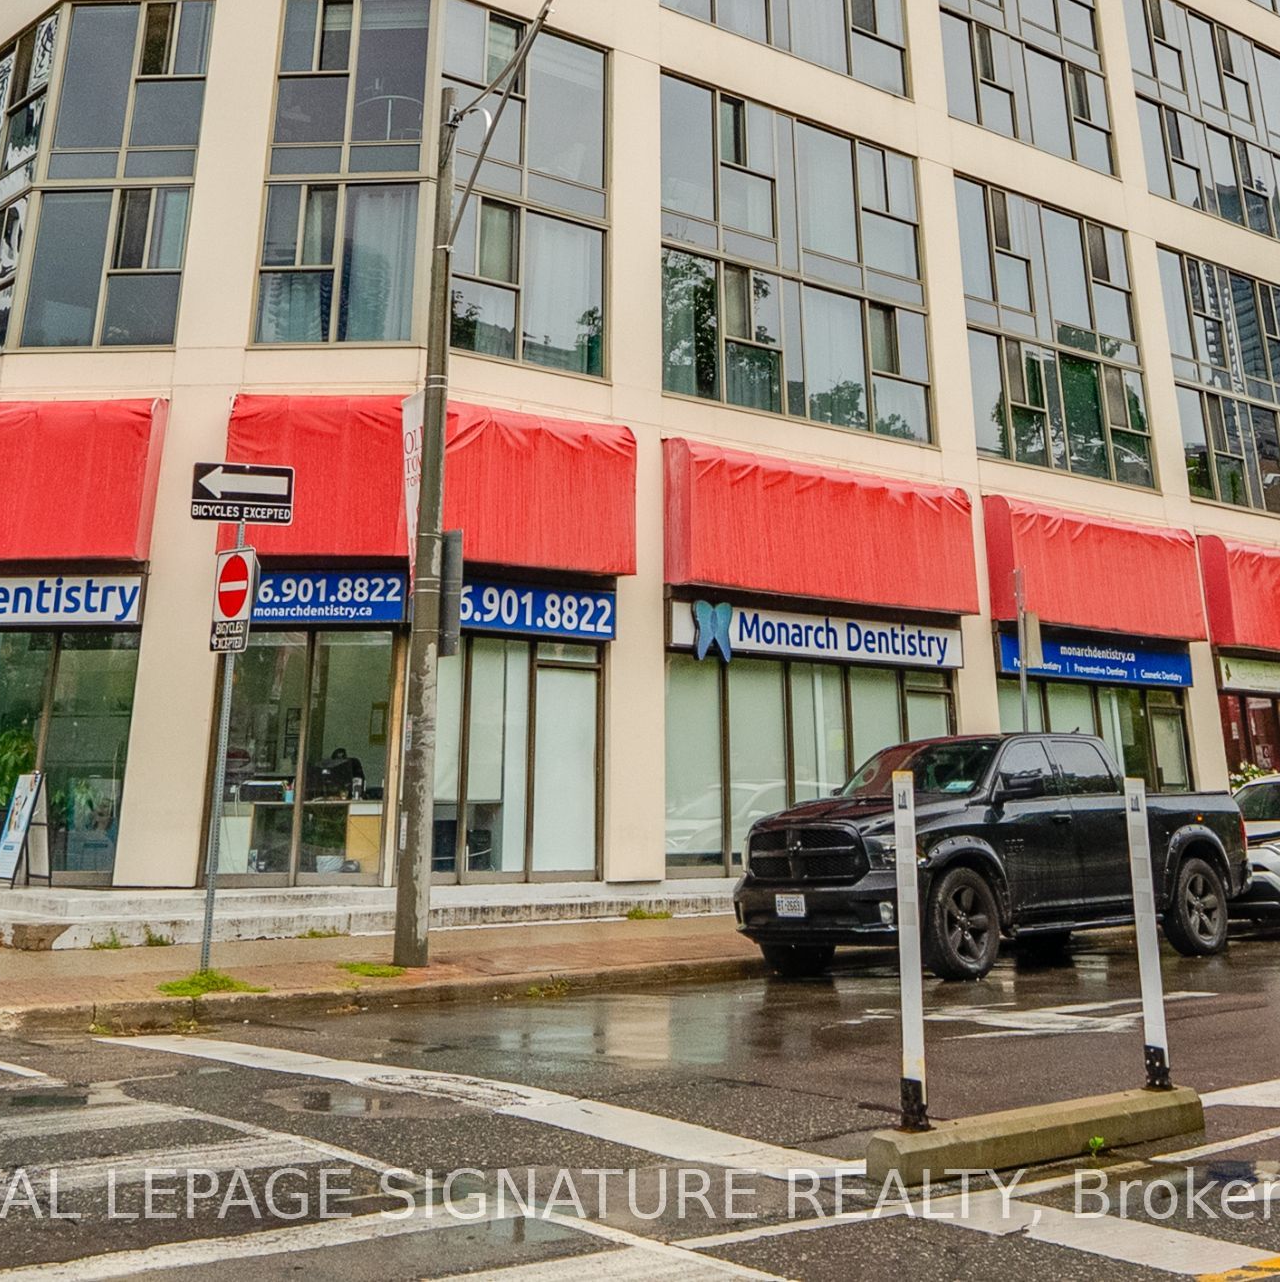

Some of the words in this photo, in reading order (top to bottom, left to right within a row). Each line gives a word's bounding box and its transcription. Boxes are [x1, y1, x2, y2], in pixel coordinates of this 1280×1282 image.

[191, 504, 240, 518] BICYCLES
[243, 507, 291, 521] EXCEPTED
[257, 576, 402, 603] 6.901.8822
[253, 604, 373, 619] monarchdentistry.ca
[460, 585, 612, 634] 6.901.8822
[215, 621, 244, 635] BICYCLES
[738, 611, 838, 650] Monarch
[846, 622, 948, 665] Dentistry
[1060, 645, 1136, 663] monarchdentistry.ca
[1106, 666, 1128, 678] Dentistry
